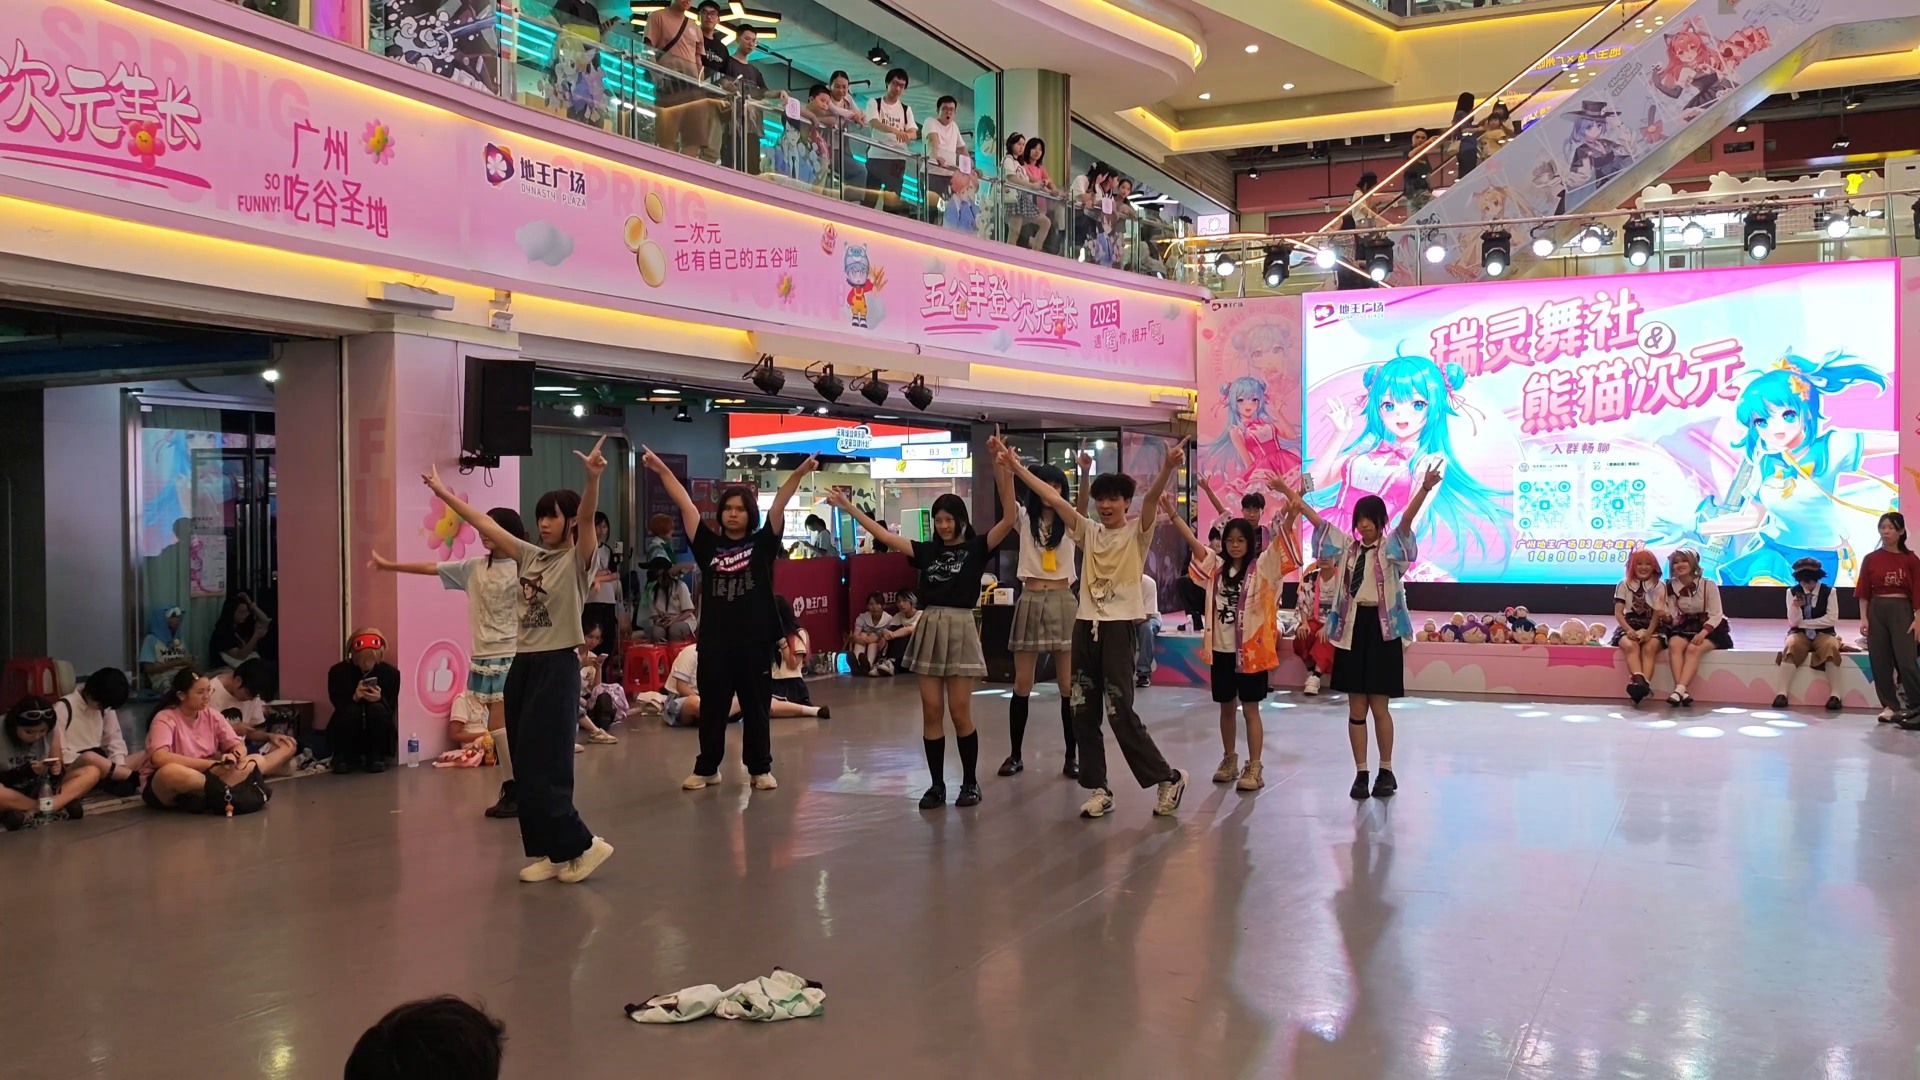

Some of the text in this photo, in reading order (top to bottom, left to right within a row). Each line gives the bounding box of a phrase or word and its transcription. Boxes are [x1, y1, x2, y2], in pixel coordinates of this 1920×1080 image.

[292, 118, 348, 175] 广州
[265, 173, 280, 190] SO
[520, 157, 586, 195] 地王广场
[238, 195, 280, 212] FUNNY!
[284, 174, 388, 238] 吃谷圣地
[521, 184, 587, 208] DYNASTY PLAZA
[674, 223, 721, 244] 二次元
[675, 246, 798, 272] 也有自己的五谷啦
[920, 270, 1012, 321] 五谷丰登
[1093, 303, 1117, 326] 2025
[1339, 301, 1384, 315] 地王广场
[1430, 288, 1645, 377] 瑞灵舞社
[1521, 338, 1746, 435] 熊猫次元
[929, 448, 940, 456] B3
[1550, 442, 1611, 455] 入群畅聊
[1528, 551, 1628, 562] 14:00-19:3
